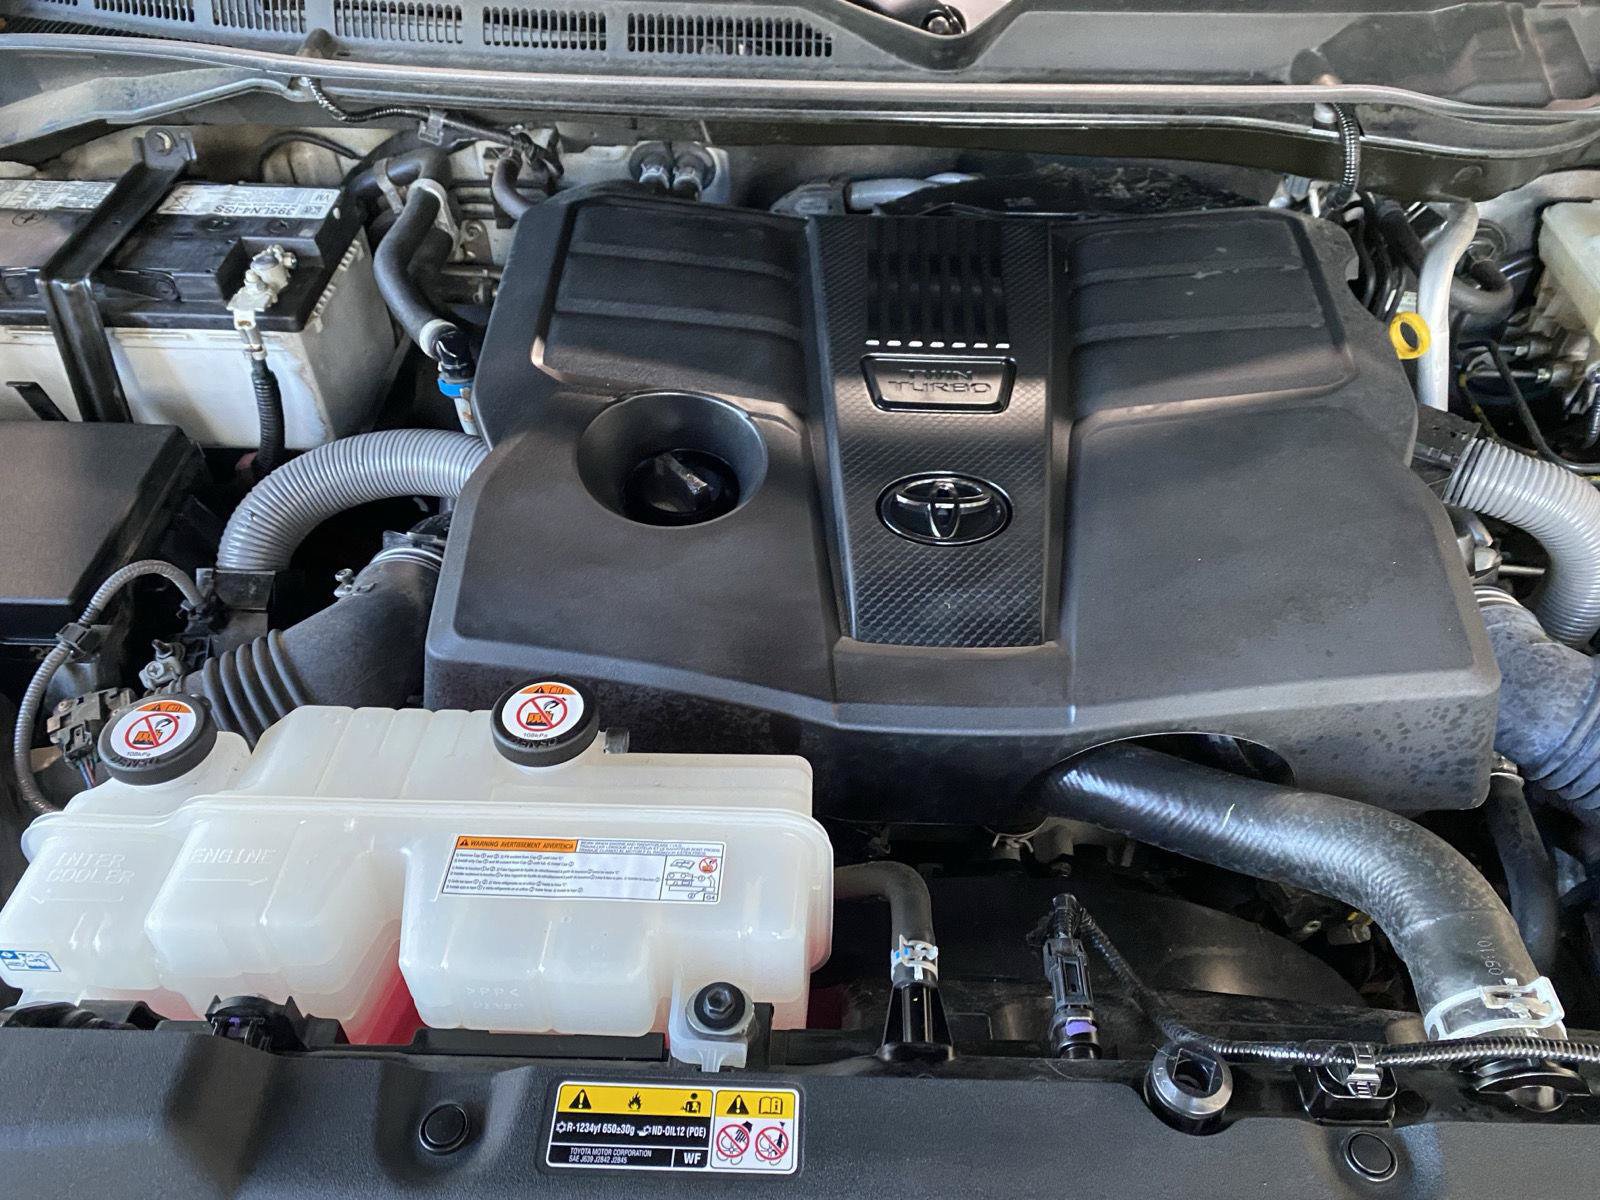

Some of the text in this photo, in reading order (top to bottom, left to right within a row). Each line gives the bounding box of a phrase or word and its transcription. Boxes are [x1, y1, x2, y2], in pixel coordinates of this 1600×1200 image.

[900, 368, 973, 380] TWIN
[888, 380, 992, 393] TURBO
[55, 851, 128, 867] INTER
[190, 848, 276, 864] ENGINE
[46, 868, 135, 884] COOLER
[566, 1122, 706, 1138] R-1234yf 650±30g ND-OIL12 (POE)
[568, 1154, 580, 1162] SAE
[580, 1155, 594, 1163] J639
[570, 1147, 653, 1157] TOYOTA MOTOR CORPORATION
[683, 1152, 702, 1165] WF
